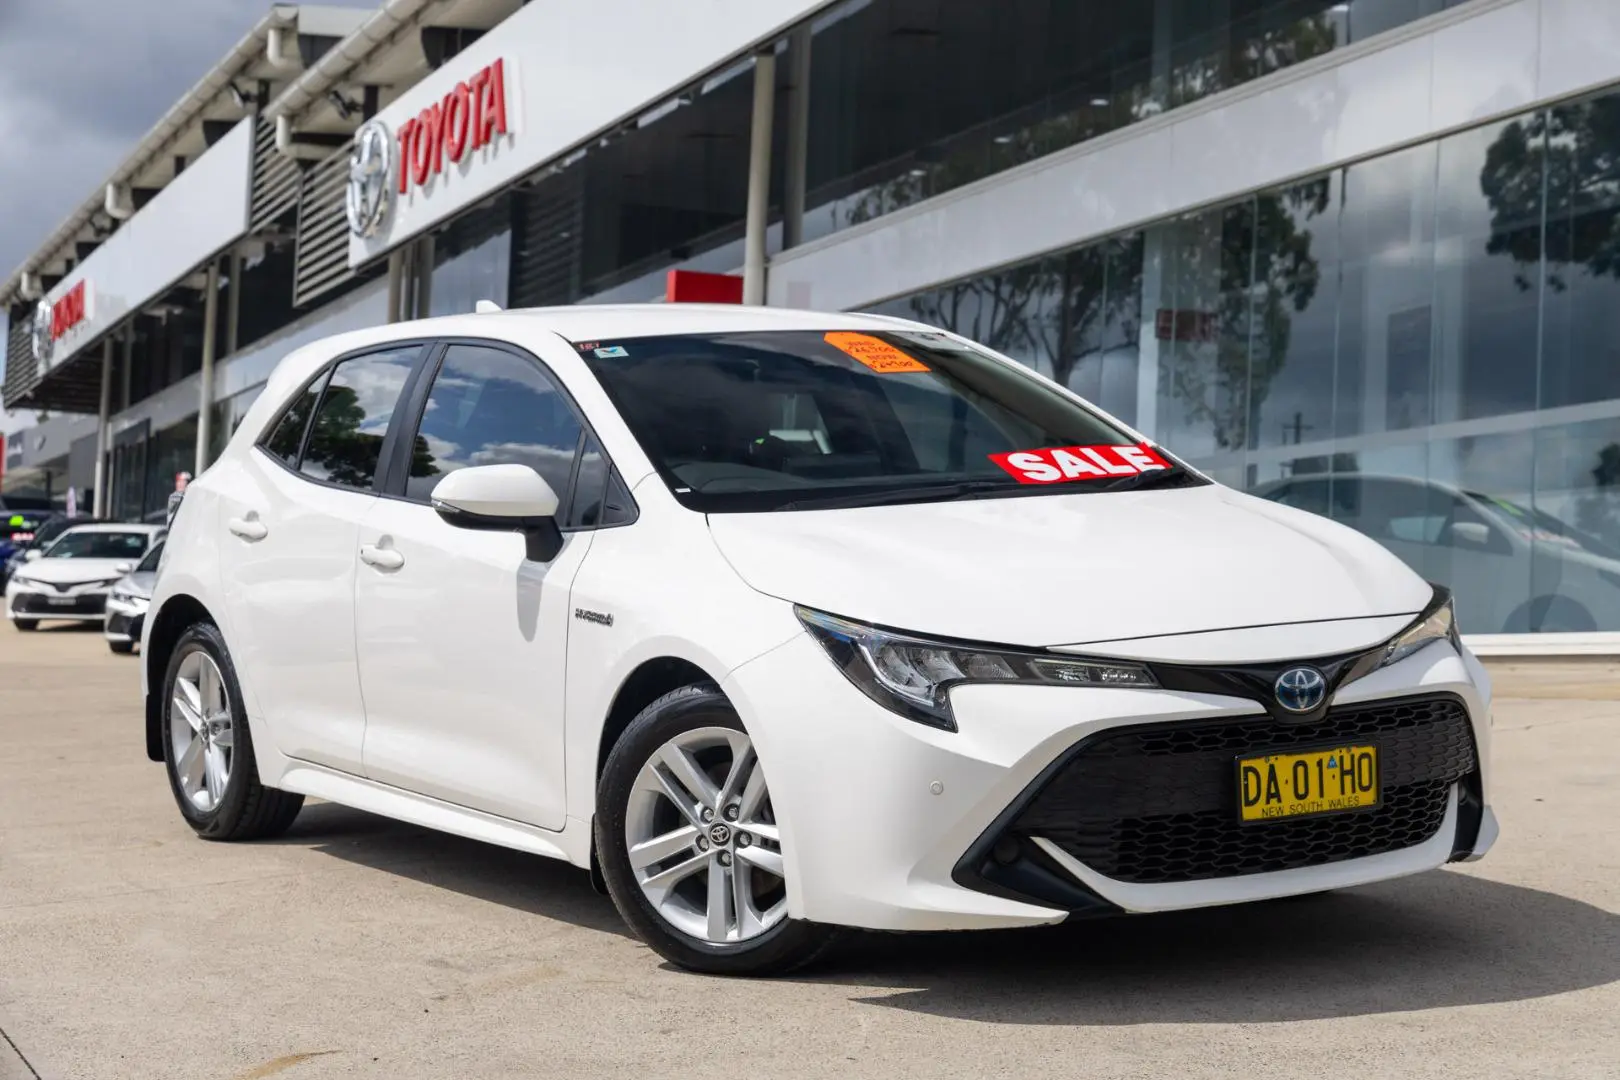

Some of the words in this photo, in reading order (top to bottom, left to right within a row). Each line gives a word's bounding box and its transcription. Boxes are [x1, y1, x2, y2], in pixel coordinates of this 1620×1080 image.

[397, 57, 506, 194] TOYOTA
[1007, 446, 1164, 482] SALE
[1262, 806, 1284, 817] NEW
[1289, 801, 1323, 814] SOUTH
[1328, 796, 1360, 808] WALES
